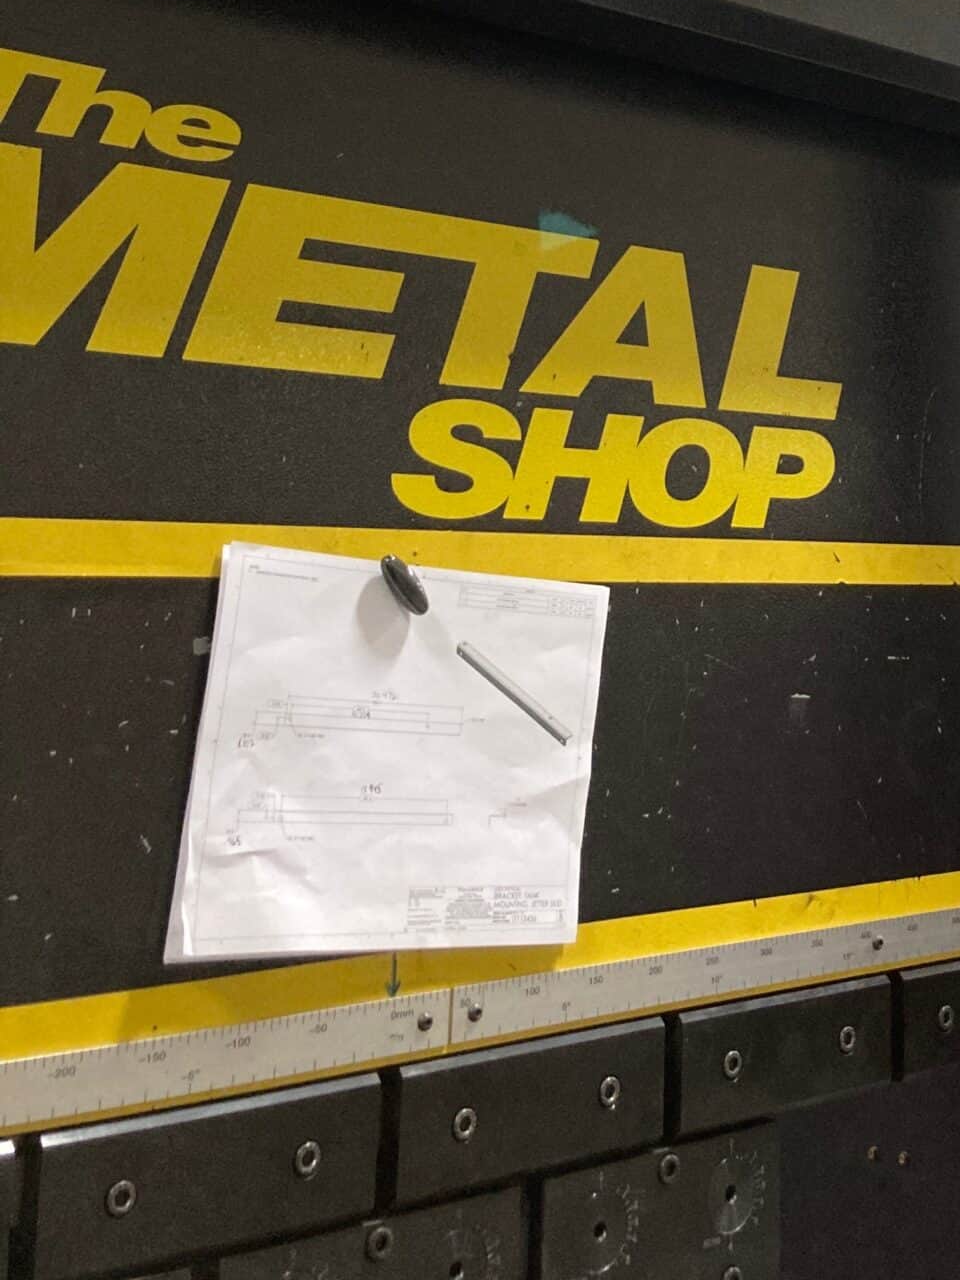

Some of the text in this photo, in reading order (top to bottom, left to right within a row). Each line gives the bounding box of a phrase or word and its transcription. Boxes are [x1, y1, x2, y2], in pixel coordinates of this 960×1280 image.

[0, 142, 844, 421] METAL
[391, 398, 837, 529] SHOP
[49, 1065, 76, 1080] -200
[139, 1050, 167, 1064] -150
[225, 1036, 251, 1050] -100
[309, 1023, 328, 1035] -50
[525, 985, 541, 997] 100
[588, 975, 605, 986] 150
[648, 966, 663, 976] 200
